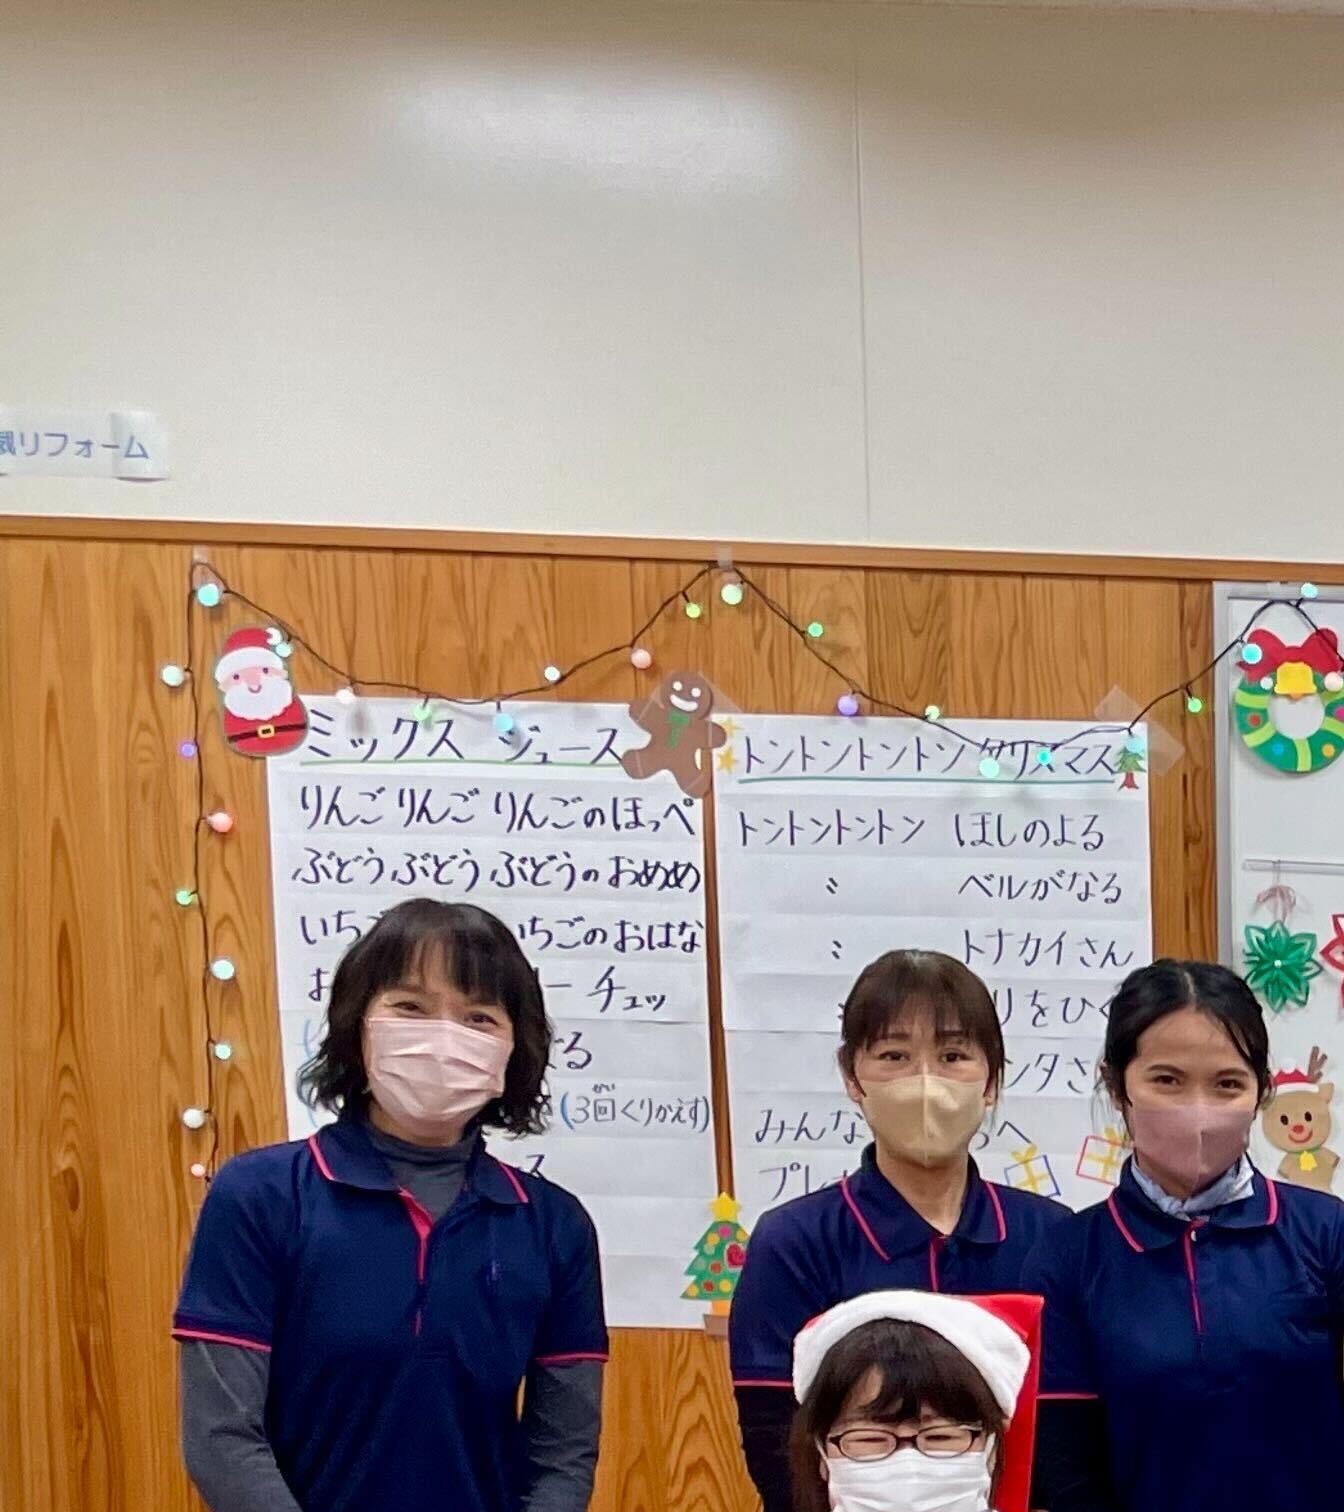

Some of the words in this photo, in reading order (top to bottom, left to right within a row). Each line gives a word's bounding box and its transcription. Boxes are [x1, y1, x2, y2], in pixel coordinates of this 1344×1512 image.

[954, 812, 1104, 852] ほしのよる
[958, 870, 1123, 905] ベルがなる
[965, 928, 1135, 968] トナカイさん
